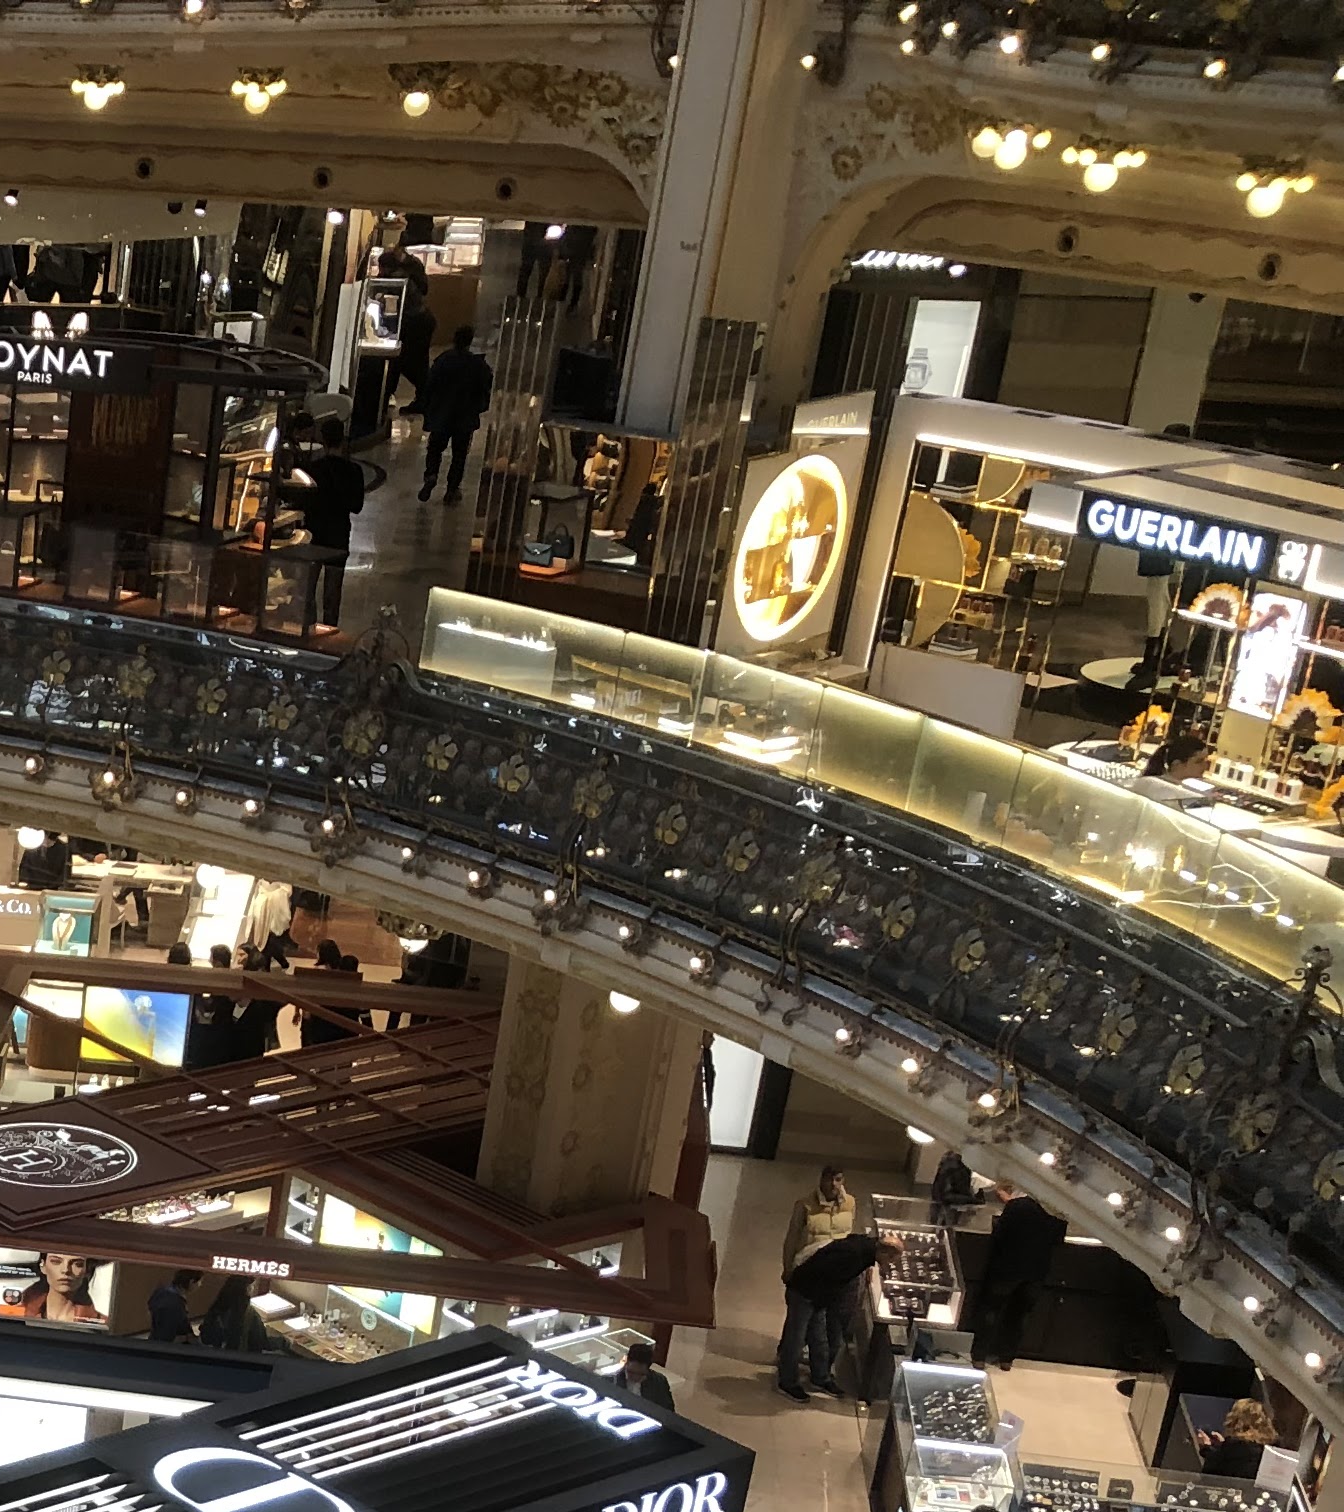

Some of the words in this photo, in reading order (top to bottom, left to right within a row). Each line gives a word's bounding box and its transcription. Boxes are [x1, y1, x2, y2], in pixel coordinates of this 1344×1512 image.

[17, 371, 53, 384] PARIS
[1087, 500, 1264, 572] GUERLAIN
[507, 1358, 663, 1441] DIOR
